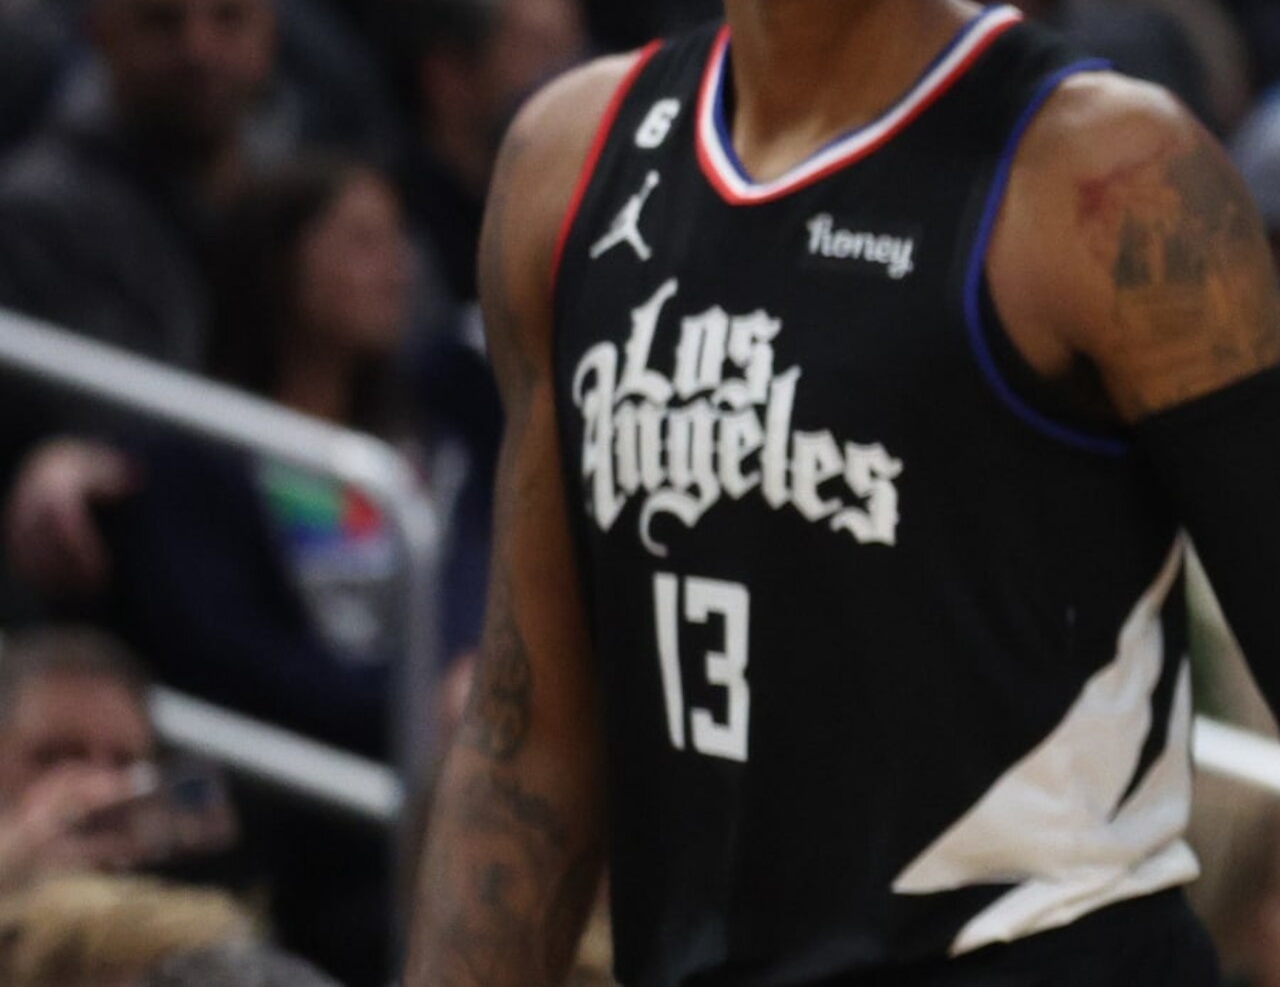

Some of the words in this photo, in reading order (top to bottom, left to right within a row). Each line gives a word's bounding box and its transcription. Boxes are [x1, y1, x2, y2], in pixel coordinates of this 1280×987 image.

[635, 98, 680, 150] 6
[806, 212, 914, 279] honey
[612, 277, 782, 411] Los
[572, 341, 903, 558] Angeles
[652, 572, 751, 764] 13
